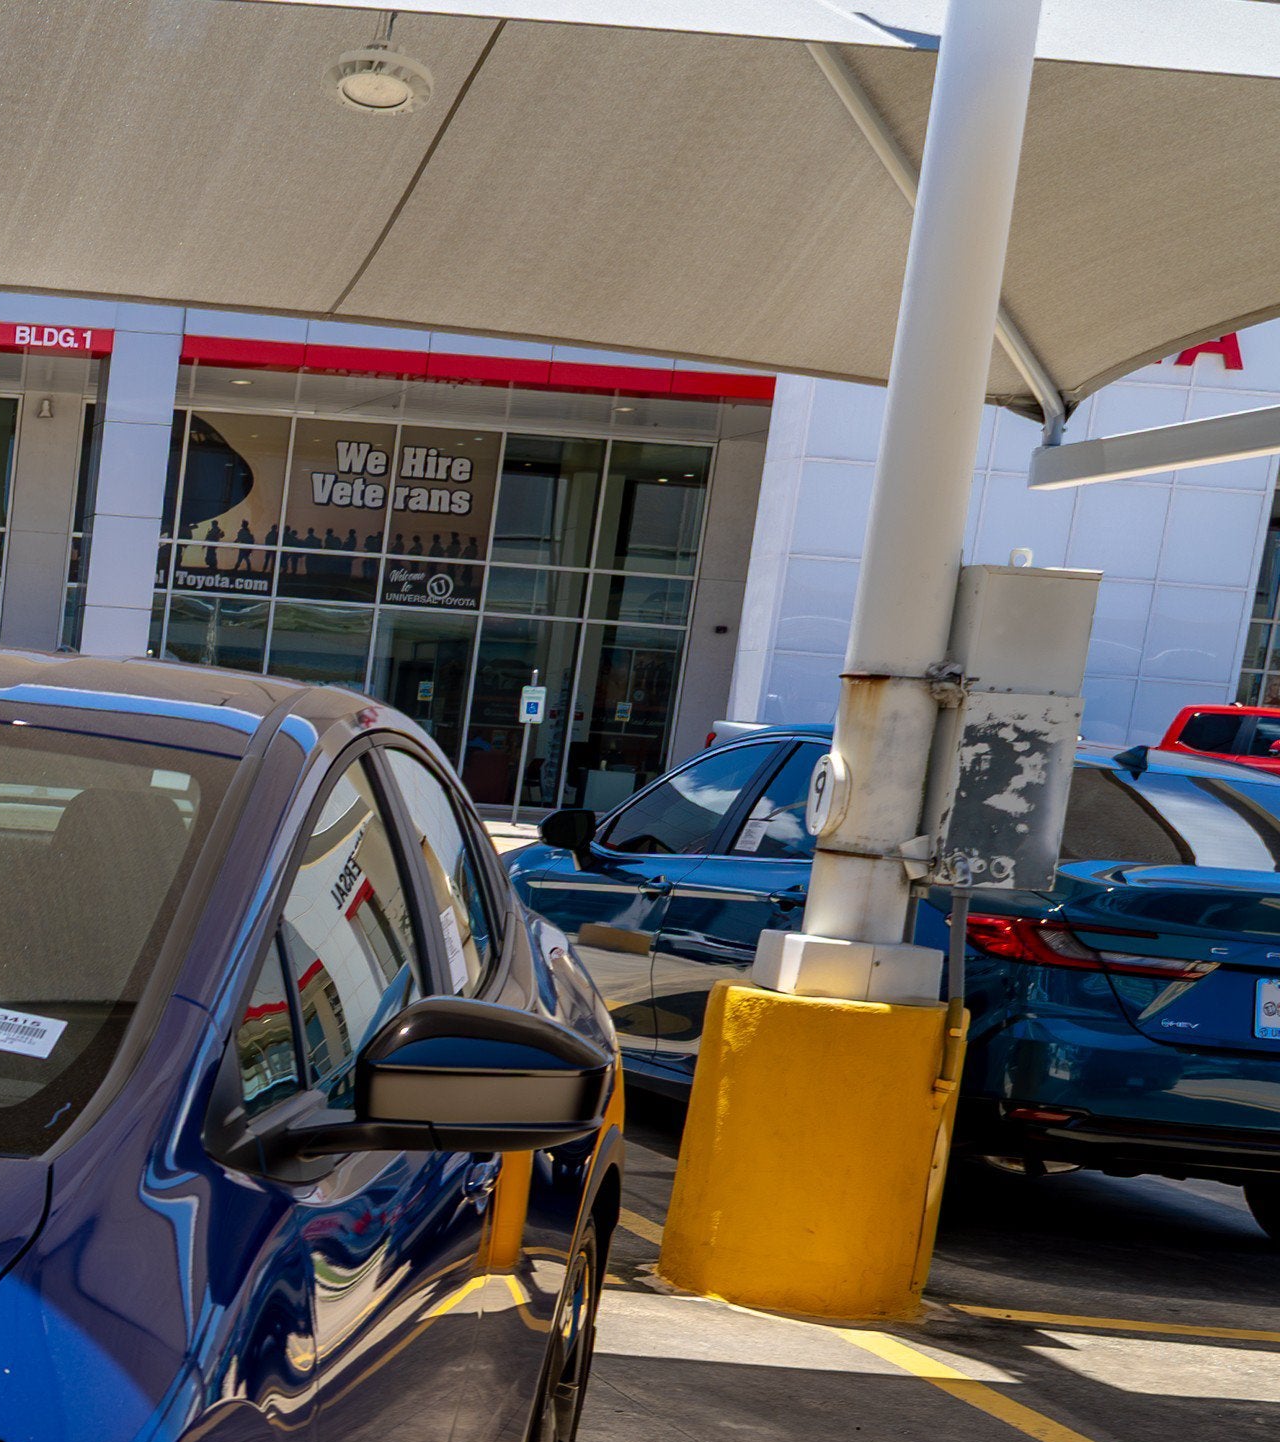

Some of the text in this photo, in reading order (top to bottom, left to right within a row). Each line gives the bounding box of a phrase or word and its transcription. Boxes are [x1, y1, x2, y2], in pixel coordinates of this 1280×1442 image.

[15, 326, 79, 348] BLDG.
[83, 331, 91, 349] 1
[336, 441, 473, 482] We Hire
[311, 472, 472, 515] Veterans
[175, 570, 268, 592] Toyota.com
[390, 568, 426, 583] Welcome
[385, 592, 476, 607] UNIVERSAL TOYOTA
